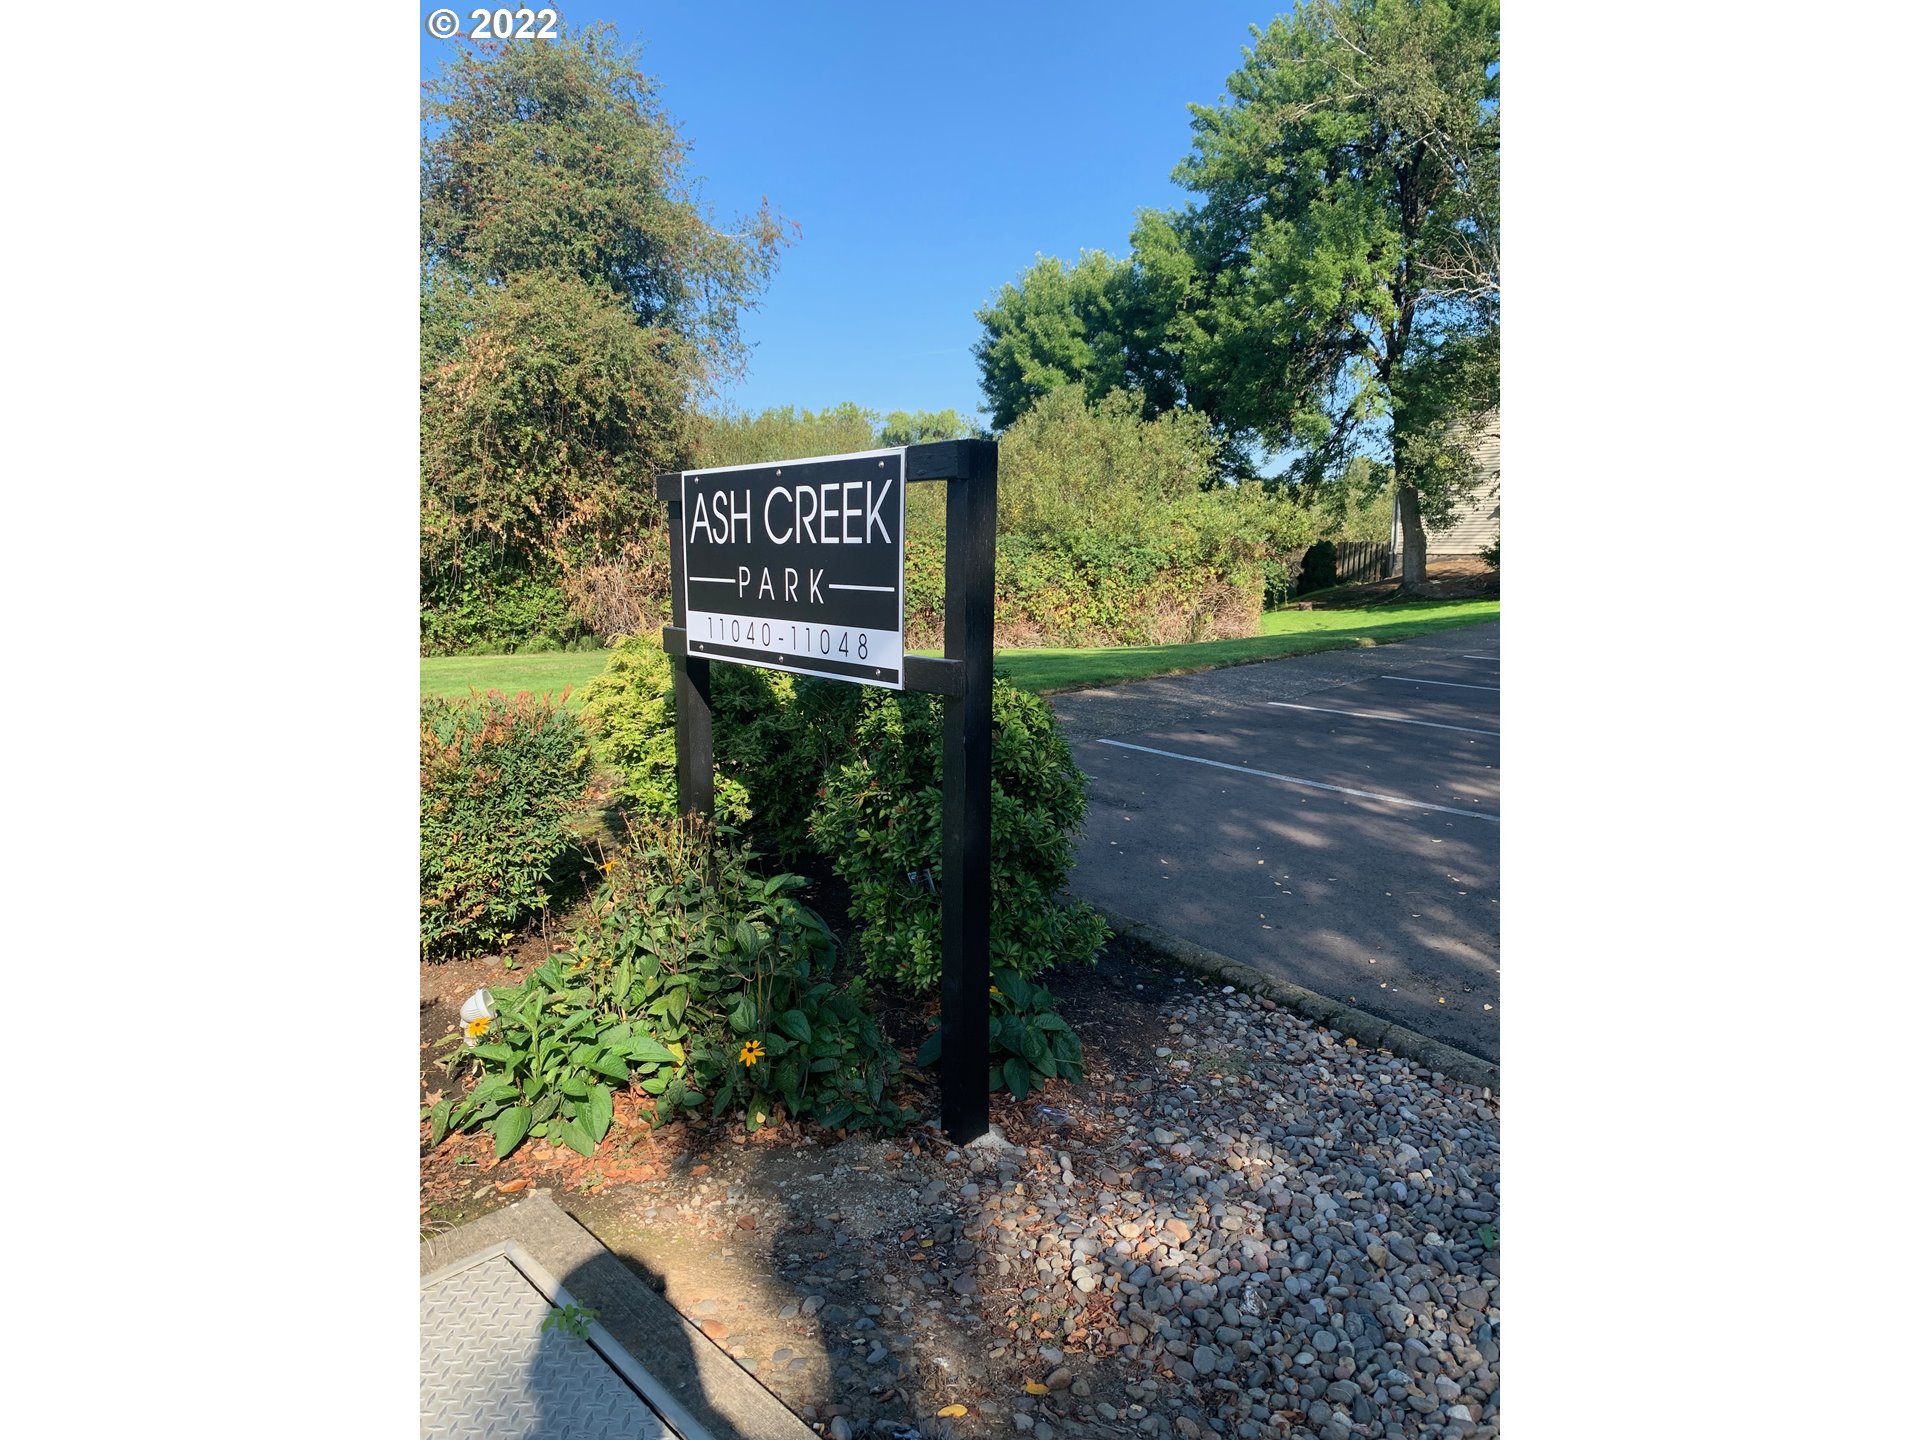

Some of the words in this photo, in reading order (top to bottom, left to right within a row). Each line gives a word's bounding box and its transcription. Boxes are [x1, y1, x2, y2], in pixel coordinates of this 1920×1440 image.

[690, 489, 751, 545] ASH
[764, 479, 893, 545] CREEK
[738, 565, 825, 604] PARK
[708, 616, 869, 660] 11040-11048
